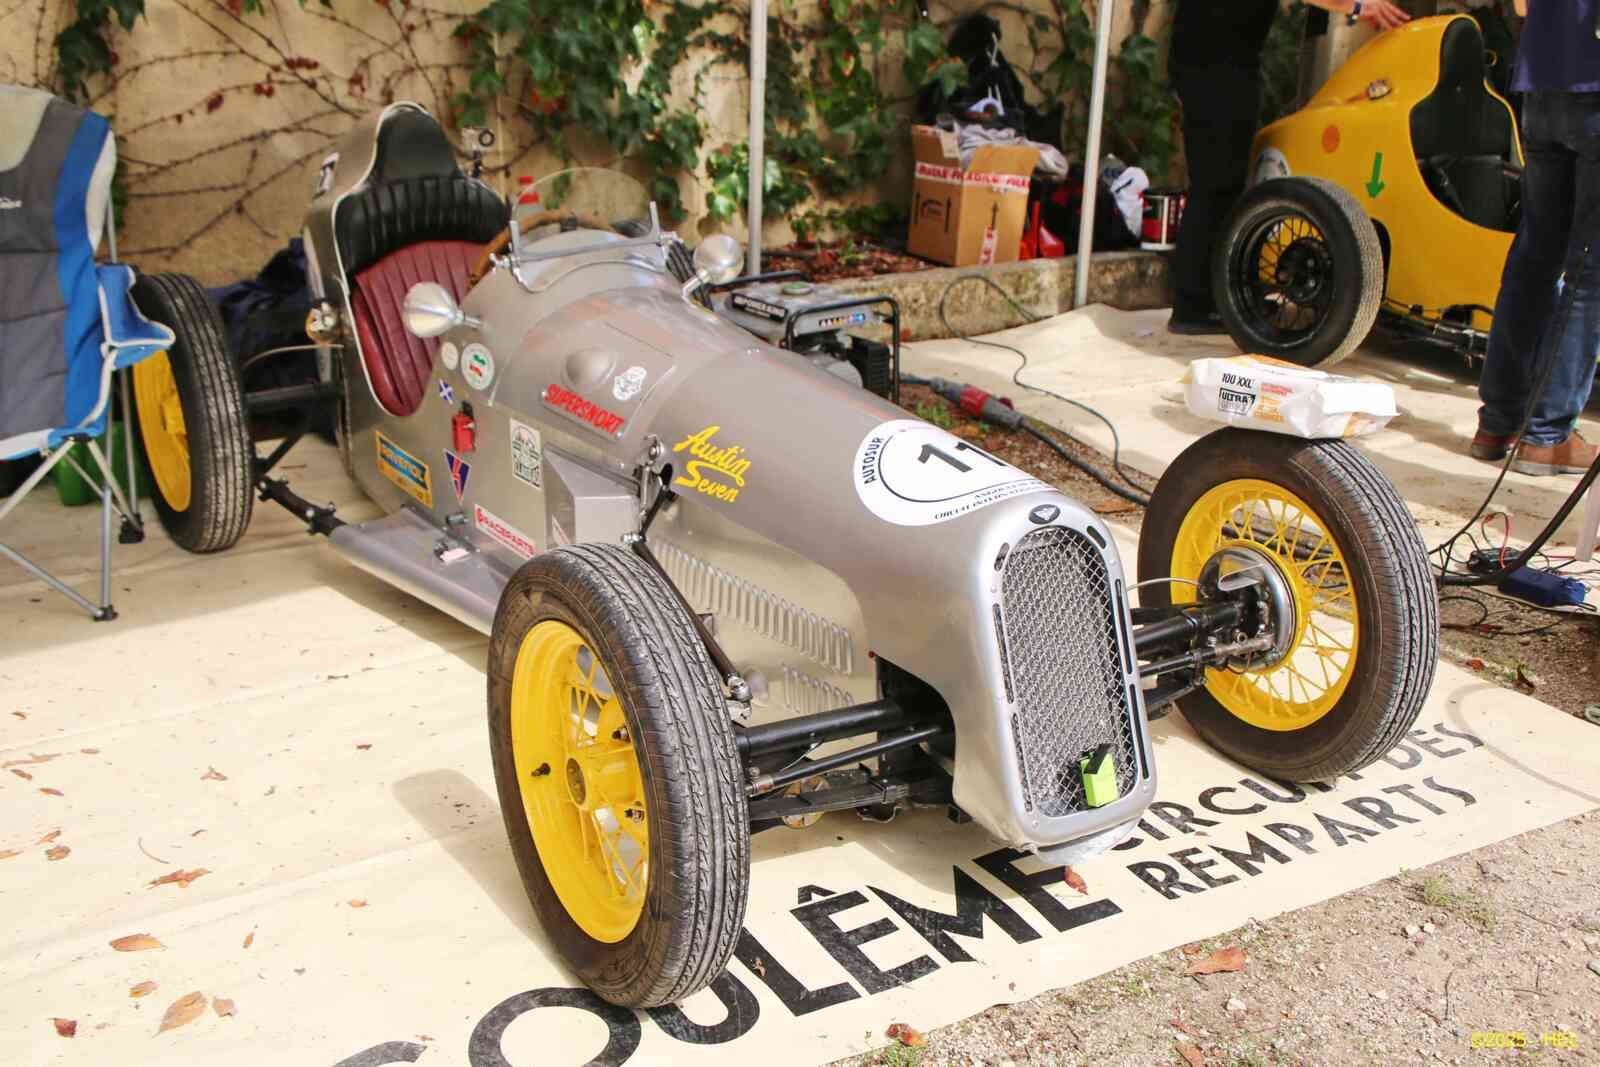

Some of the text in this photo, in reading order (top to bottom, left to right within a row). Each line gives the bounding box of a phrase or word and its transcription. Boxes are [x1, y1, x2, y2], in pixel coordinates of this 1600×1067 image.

[1222, 373, 1252, 389] 100 XXL
[1222, 392, 1248, 404] ULTRA
[545, 384, 625, 434] SUPERSNORT
[672, 425, 752, 475] Austin
[863, 436, 884, 485] AUTOSUR
[673, 460, 744, 503] Seven
[1127, 776, 1477, 900] REMPARTS
[331, 846, 1123, 1067] OULÊME
